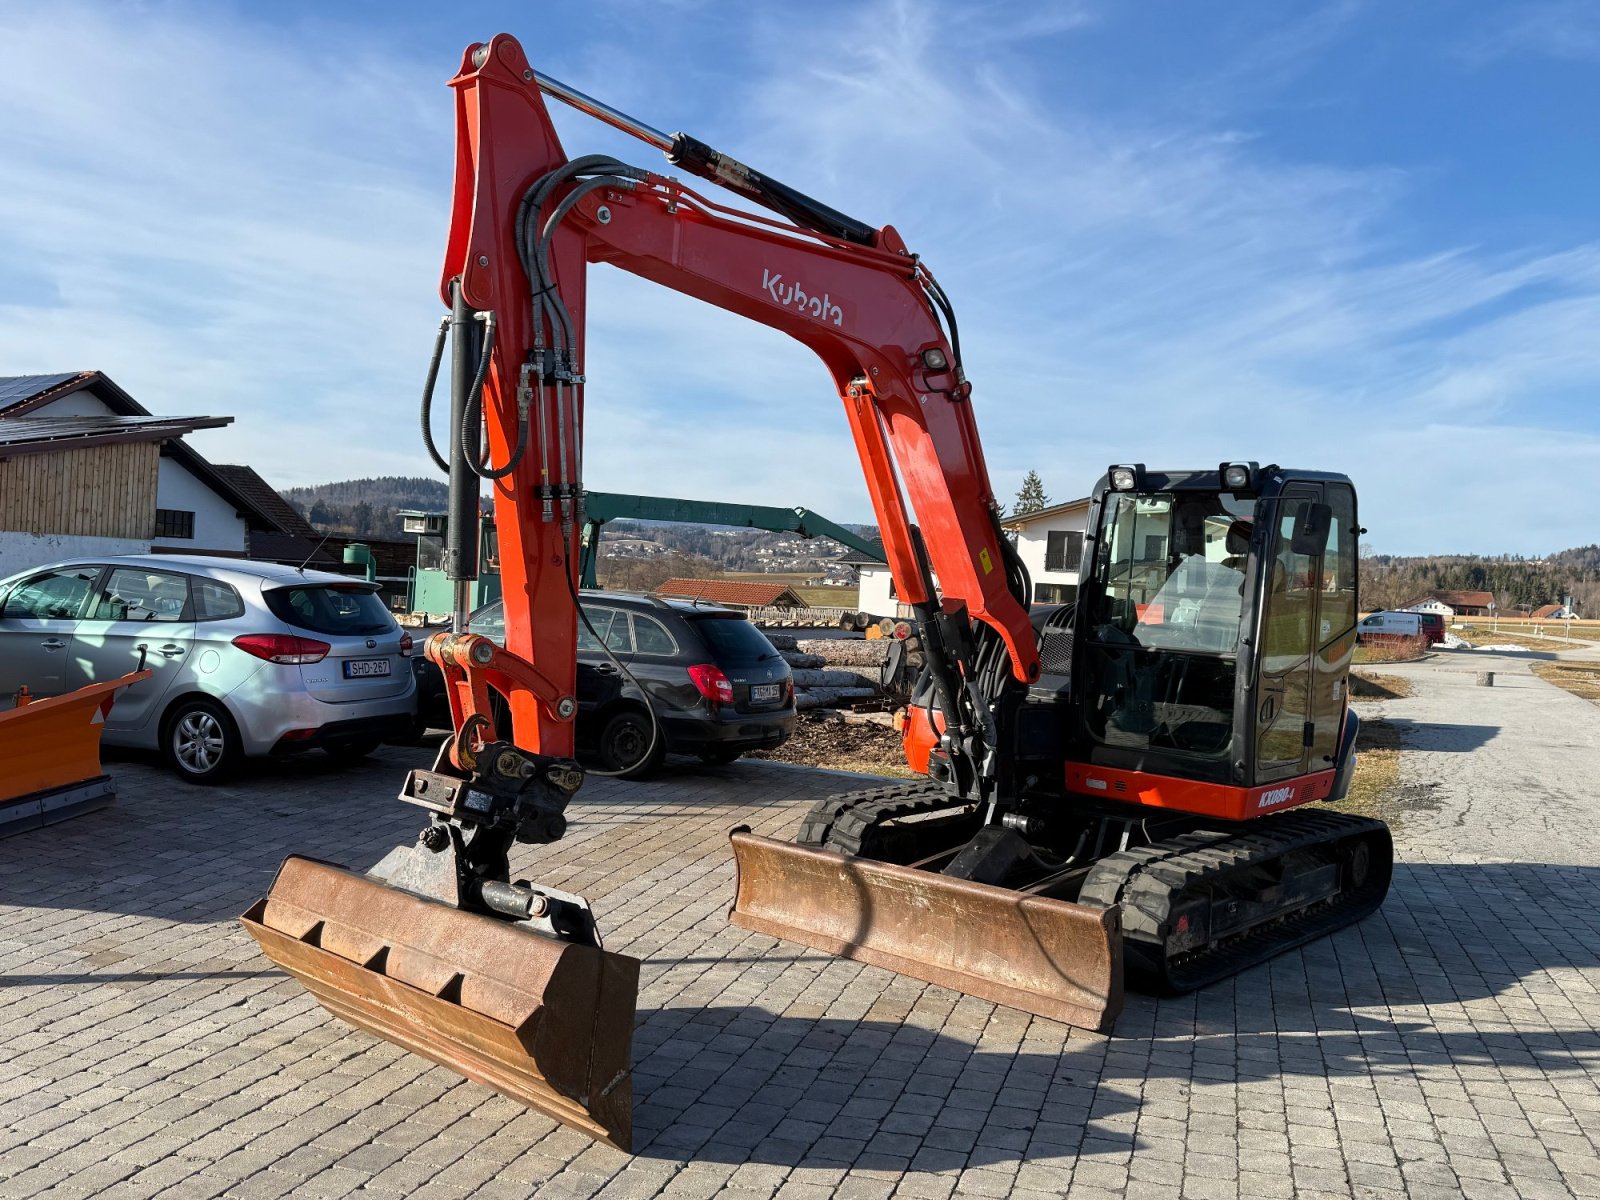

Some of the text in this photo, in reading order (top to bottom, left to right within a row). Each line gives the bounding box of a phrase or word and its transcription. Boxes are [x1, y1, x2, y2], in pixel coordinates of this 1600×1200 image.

[762, 268, 843, 327] Kubota
[352, 661, 388, 675] SHD-267
[1258, 786, 1296, 808] KX080-4
